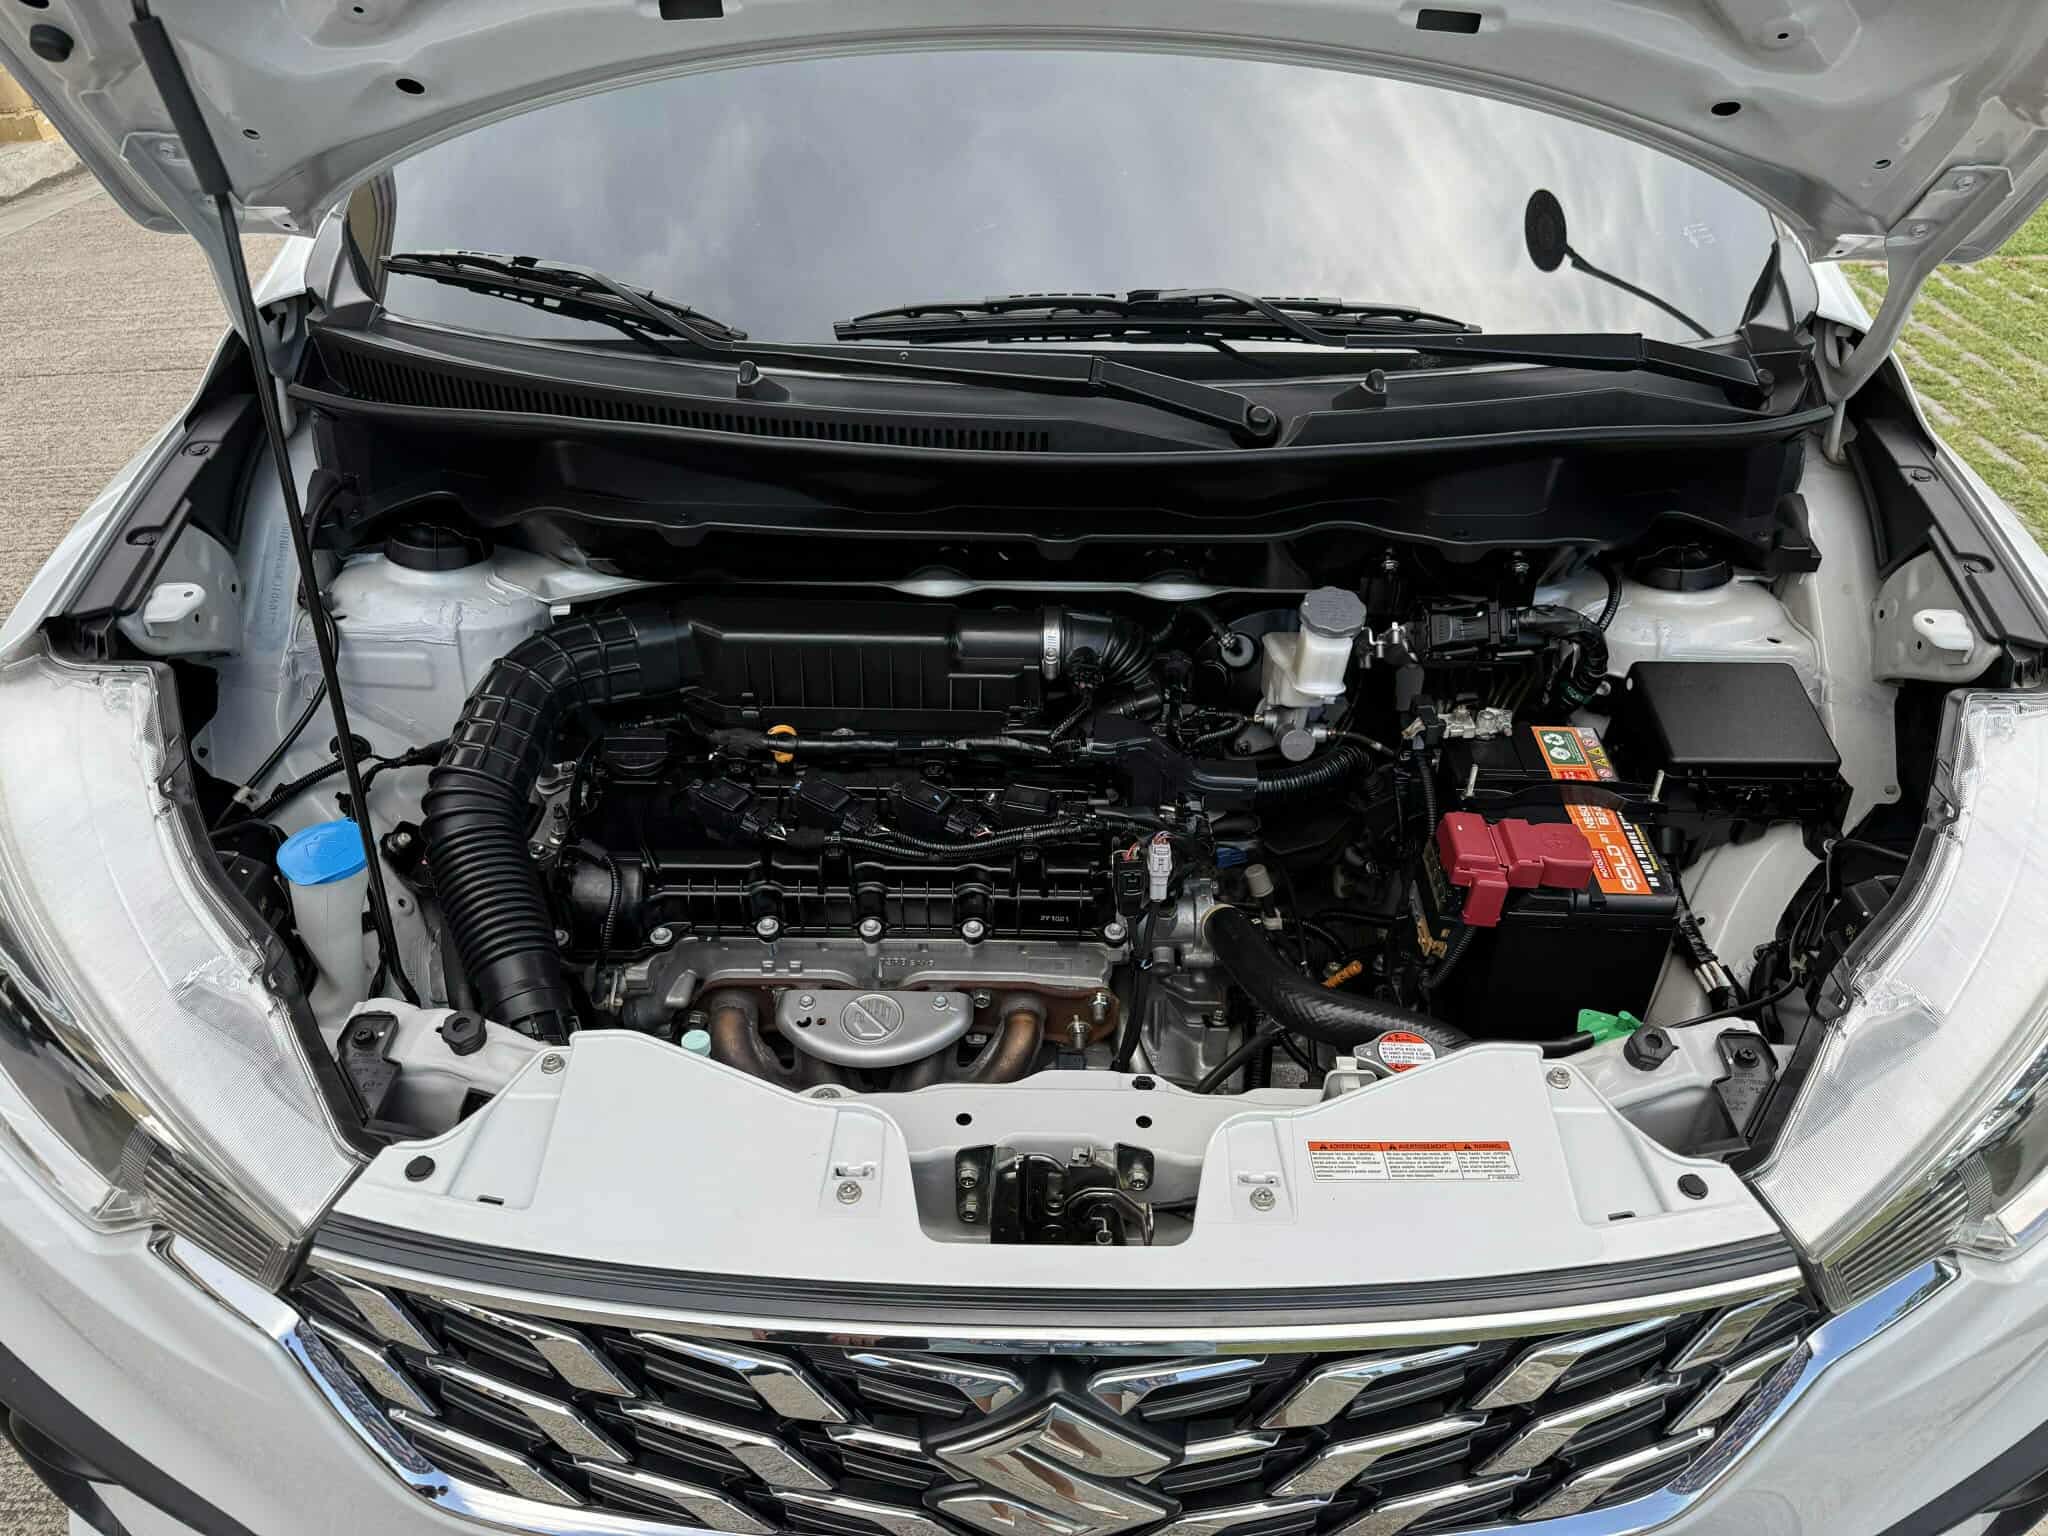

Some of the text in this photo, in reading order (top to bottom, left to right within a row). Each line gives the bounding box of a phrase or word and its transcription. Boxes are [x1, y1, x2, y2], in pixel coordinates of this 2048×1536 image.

[1625, 831, 1647, 858] REMOVE
[1606, 845, 1637, 891] GOLD
[1640, 858, 1655, 875] NOT
